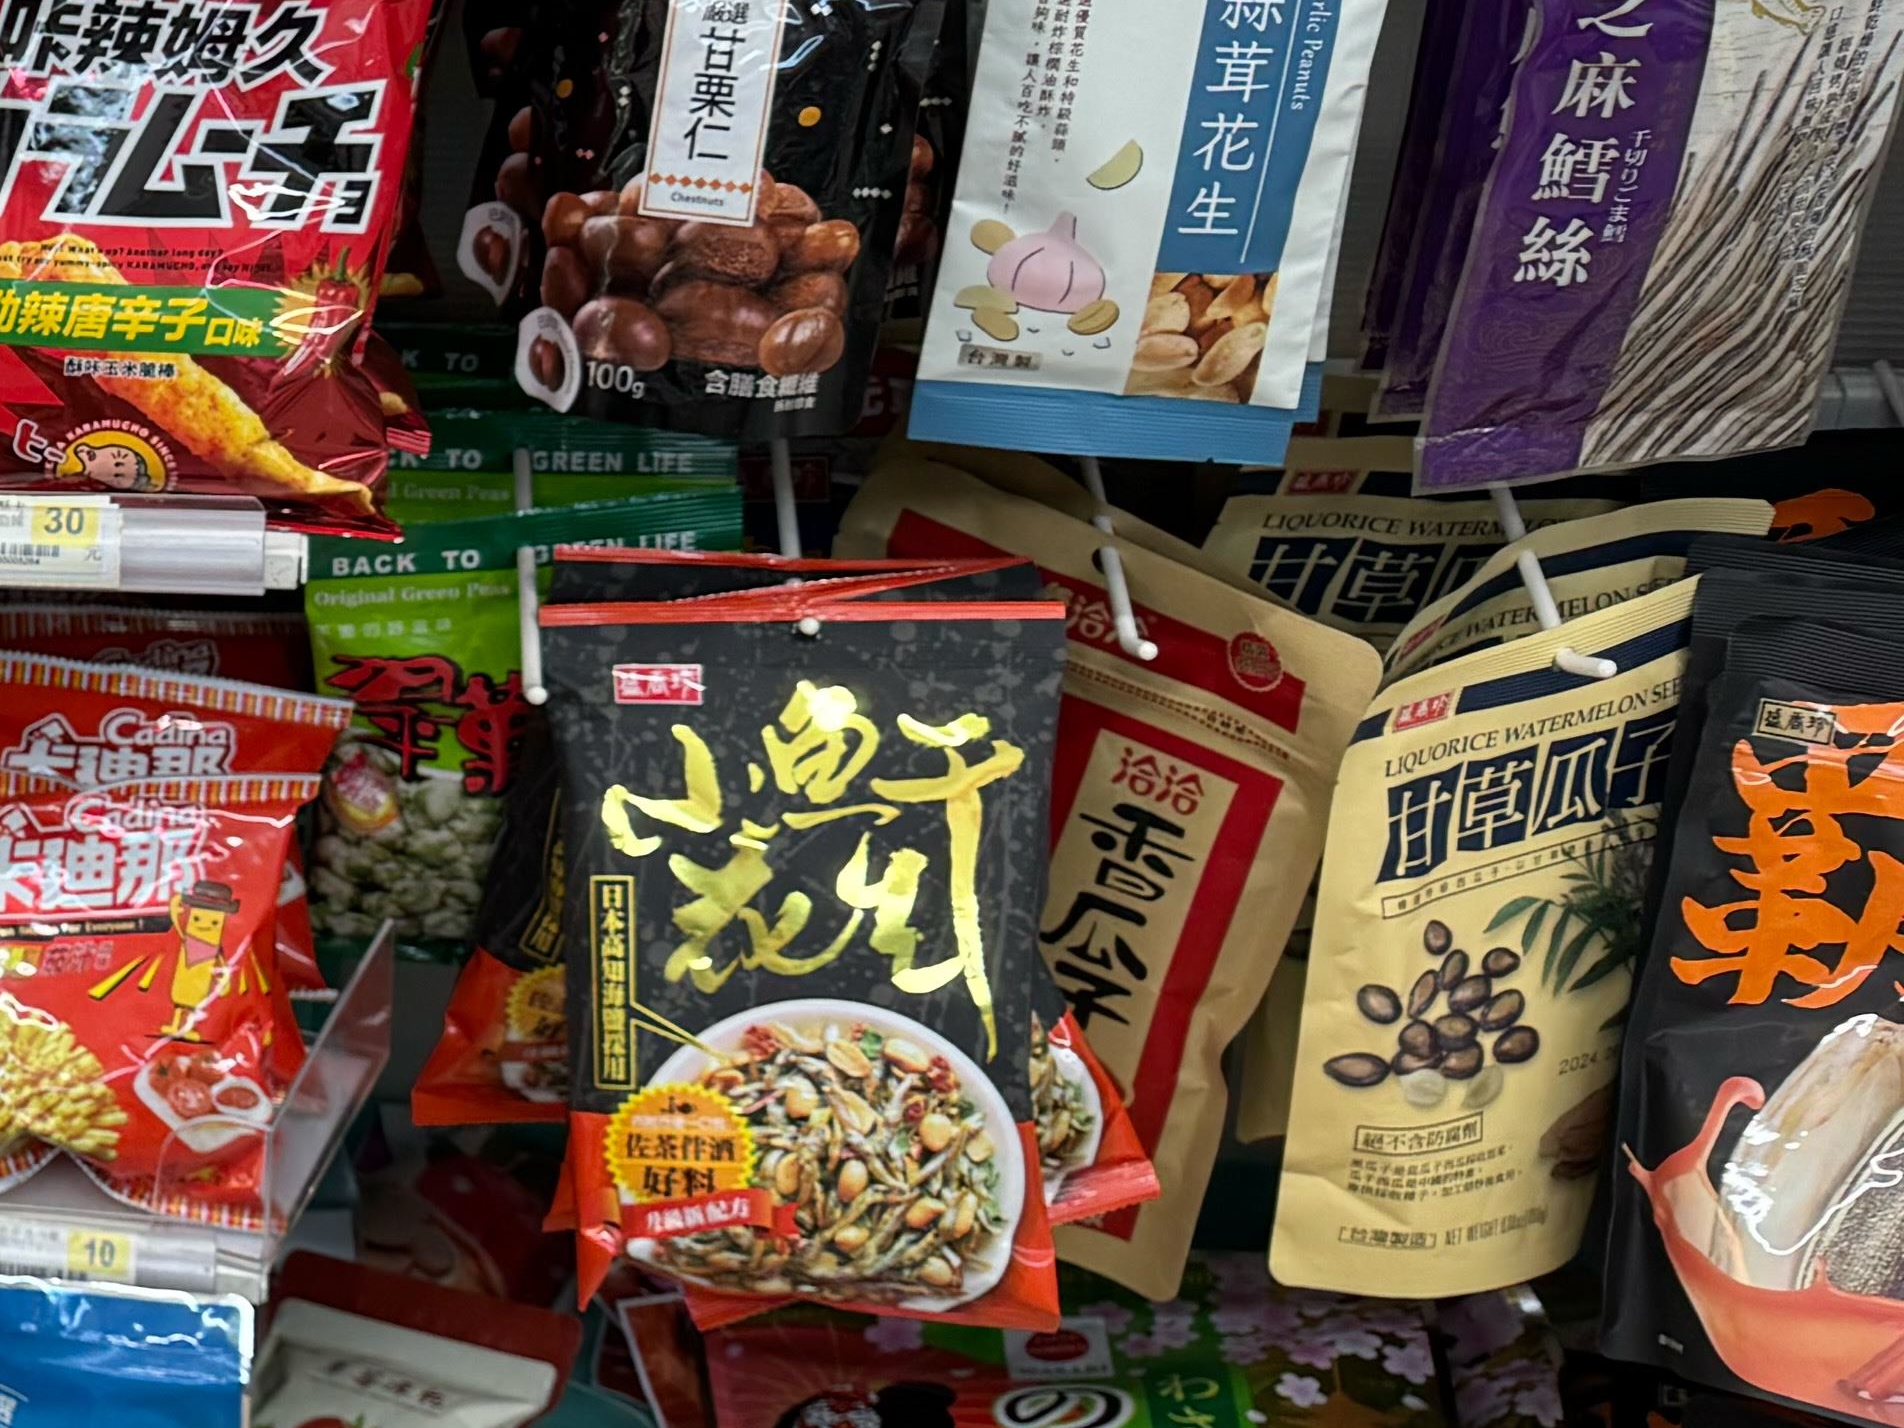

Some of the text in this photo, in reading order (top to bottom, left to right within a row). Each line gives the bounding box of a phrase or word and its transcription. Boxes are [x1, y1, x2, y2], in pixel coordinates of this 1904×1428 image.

[703, 0, 750, 25] 嚴選
[1290, 37, 1325, 112] Peanuts
[683, 26, 747, 163] 甘栗仁
[671, 191, 724, 208] Chestnuts
[1599, 128, 1653, 247] 千切りごま鱈
[965, 346, 1037, 371] 台灣製
[587, 361, 646, 400] 100g
[703, 368, 822, 402] 含膳食纖維
[446, 450, 695, 474] TO GREEN LIFE
[43, 507, 85, 534] 30
[1262, 512, 1402, 536] LIQUORICE
[332, 548, 481, 577] BACK TO
[314, 585, 397, 609] Original
[401, 584, 461, 603] Green
[104, 714, 233, 748] Cadina
[1384, 729, 1499, 779] LIQUORICE
[1504, 685, 1650, 744] WATERMELON
[1110, 746, 1206, 817] 洽洽
[1380, 720, 1675, 880] 甘草瓜子
[601, 679, 1026, 1062] 小魚干
[665, 817, 967, 996] 花生
[1361, 1119, 1480, 1152] 絕不含防腐劑
[643, 1164, 717, 1199] 好料
[83, 1240, 116, 1267] 10
